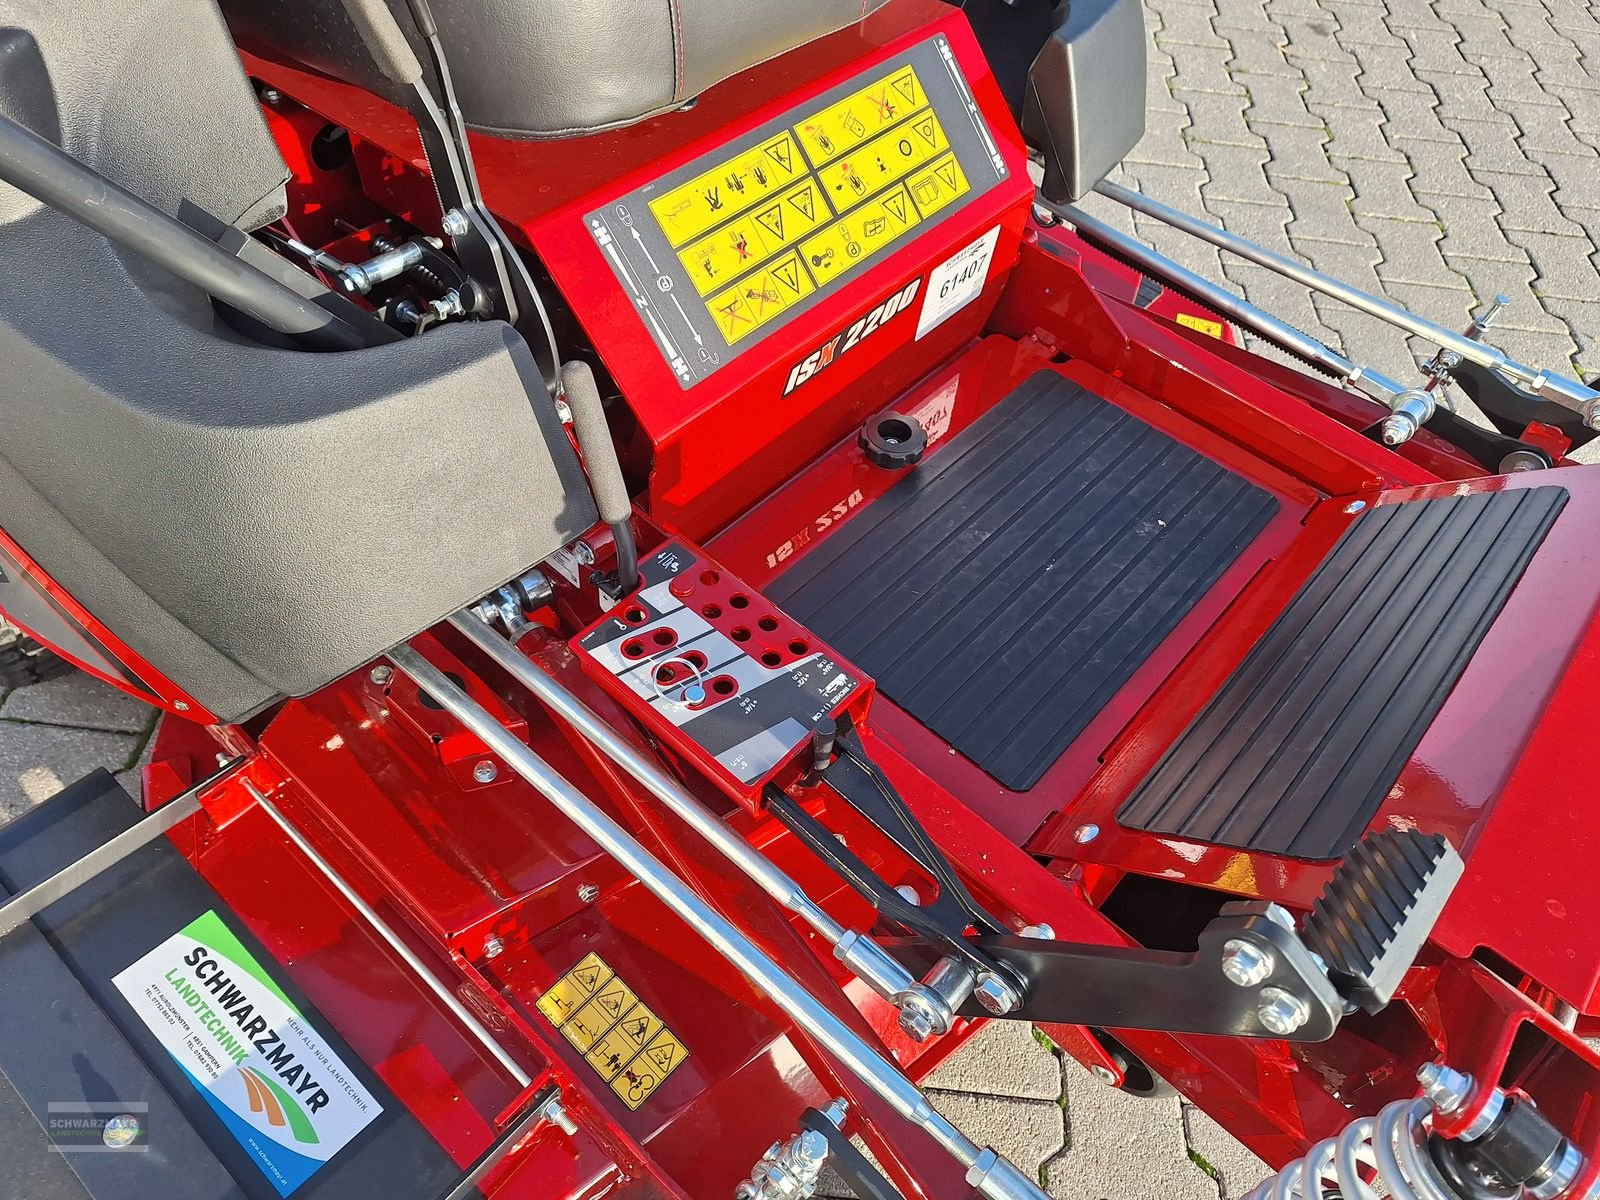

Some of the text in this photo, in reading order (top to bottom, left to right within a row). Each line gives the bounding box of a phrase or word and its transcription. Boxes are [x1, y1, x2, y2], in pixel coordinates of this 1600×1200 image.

[940, 252, 987, 298] 61407
[783, 334, 841, 396] ISX
[841, 278, 921, 354] 2200
[812, 711, 823, 722] CM
[831, 685, 850, 704] INCHES
[151, 984, 191, 1031] 4971 AUROLZMÜNSTER
[164, 968, 250, 1066] LANDTECHNIK
[184, 946, 330, 1115] SCHWARZMAYR
[193, 1035, 221, 1070] 4851 GAMPERN
[286, 1017, 368, 1114] MEHR ALS NUR LANDTECHNIK.
[248, 1137, 288, 1186] www.schwarzmayr.at
